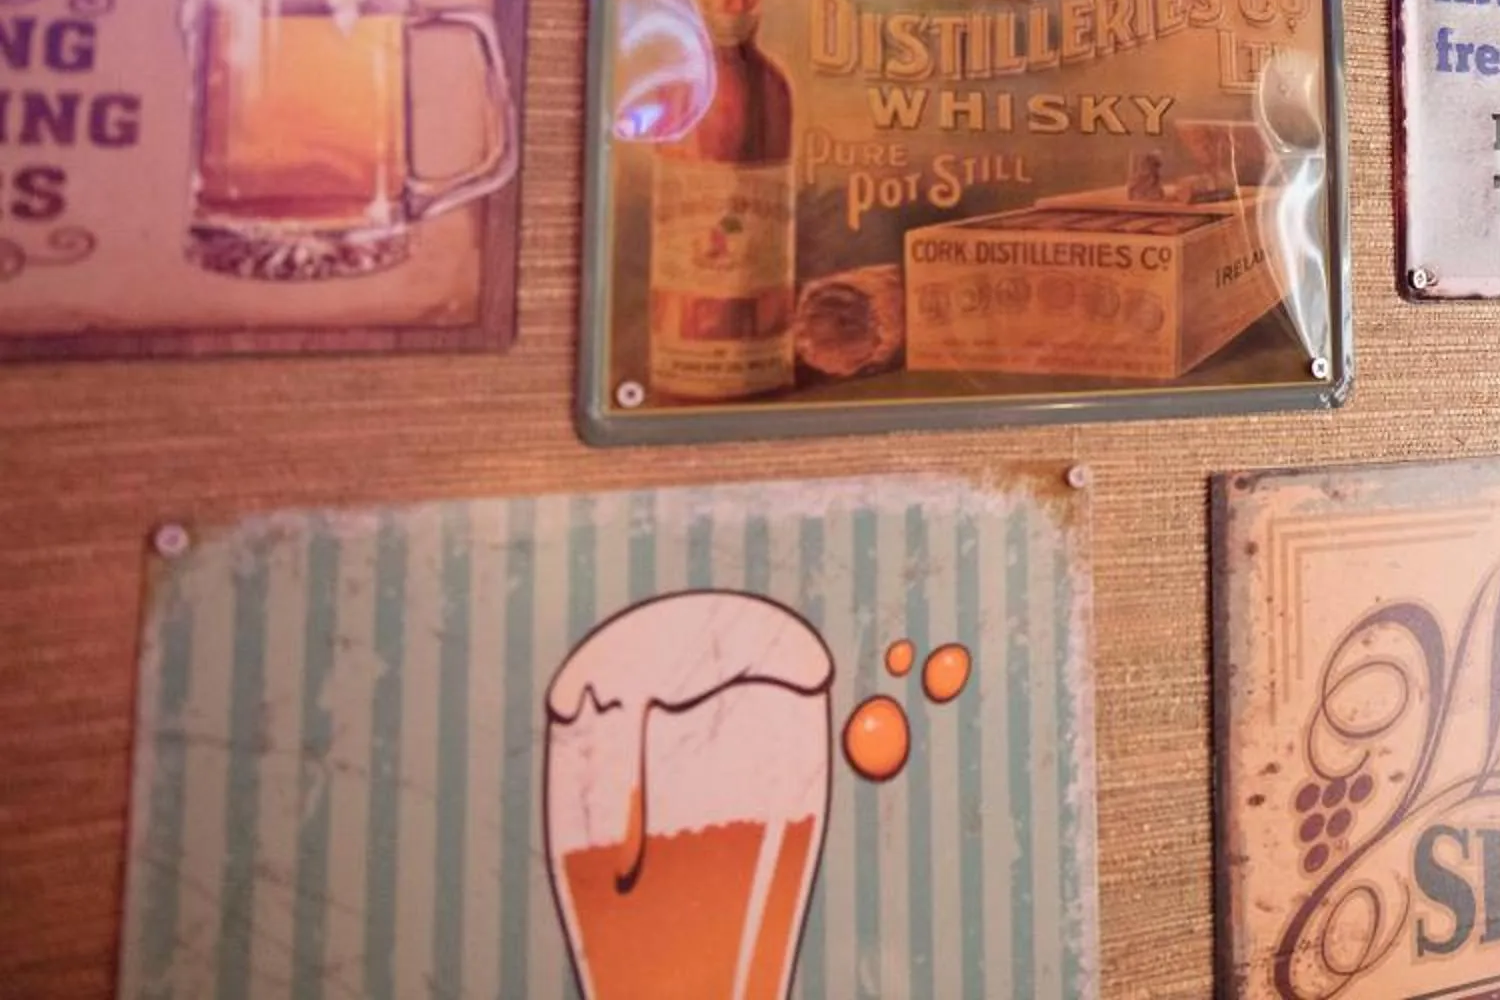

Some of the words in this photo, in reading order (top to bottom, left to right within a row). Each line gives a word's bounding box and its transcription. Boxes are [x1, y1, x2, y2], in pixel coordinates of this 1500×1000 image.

[868, 86, 1175, 137] WHISKY
[911, 238, 968, 264] CORK
[975, 241, 1133, 271] DISTILLERIES
